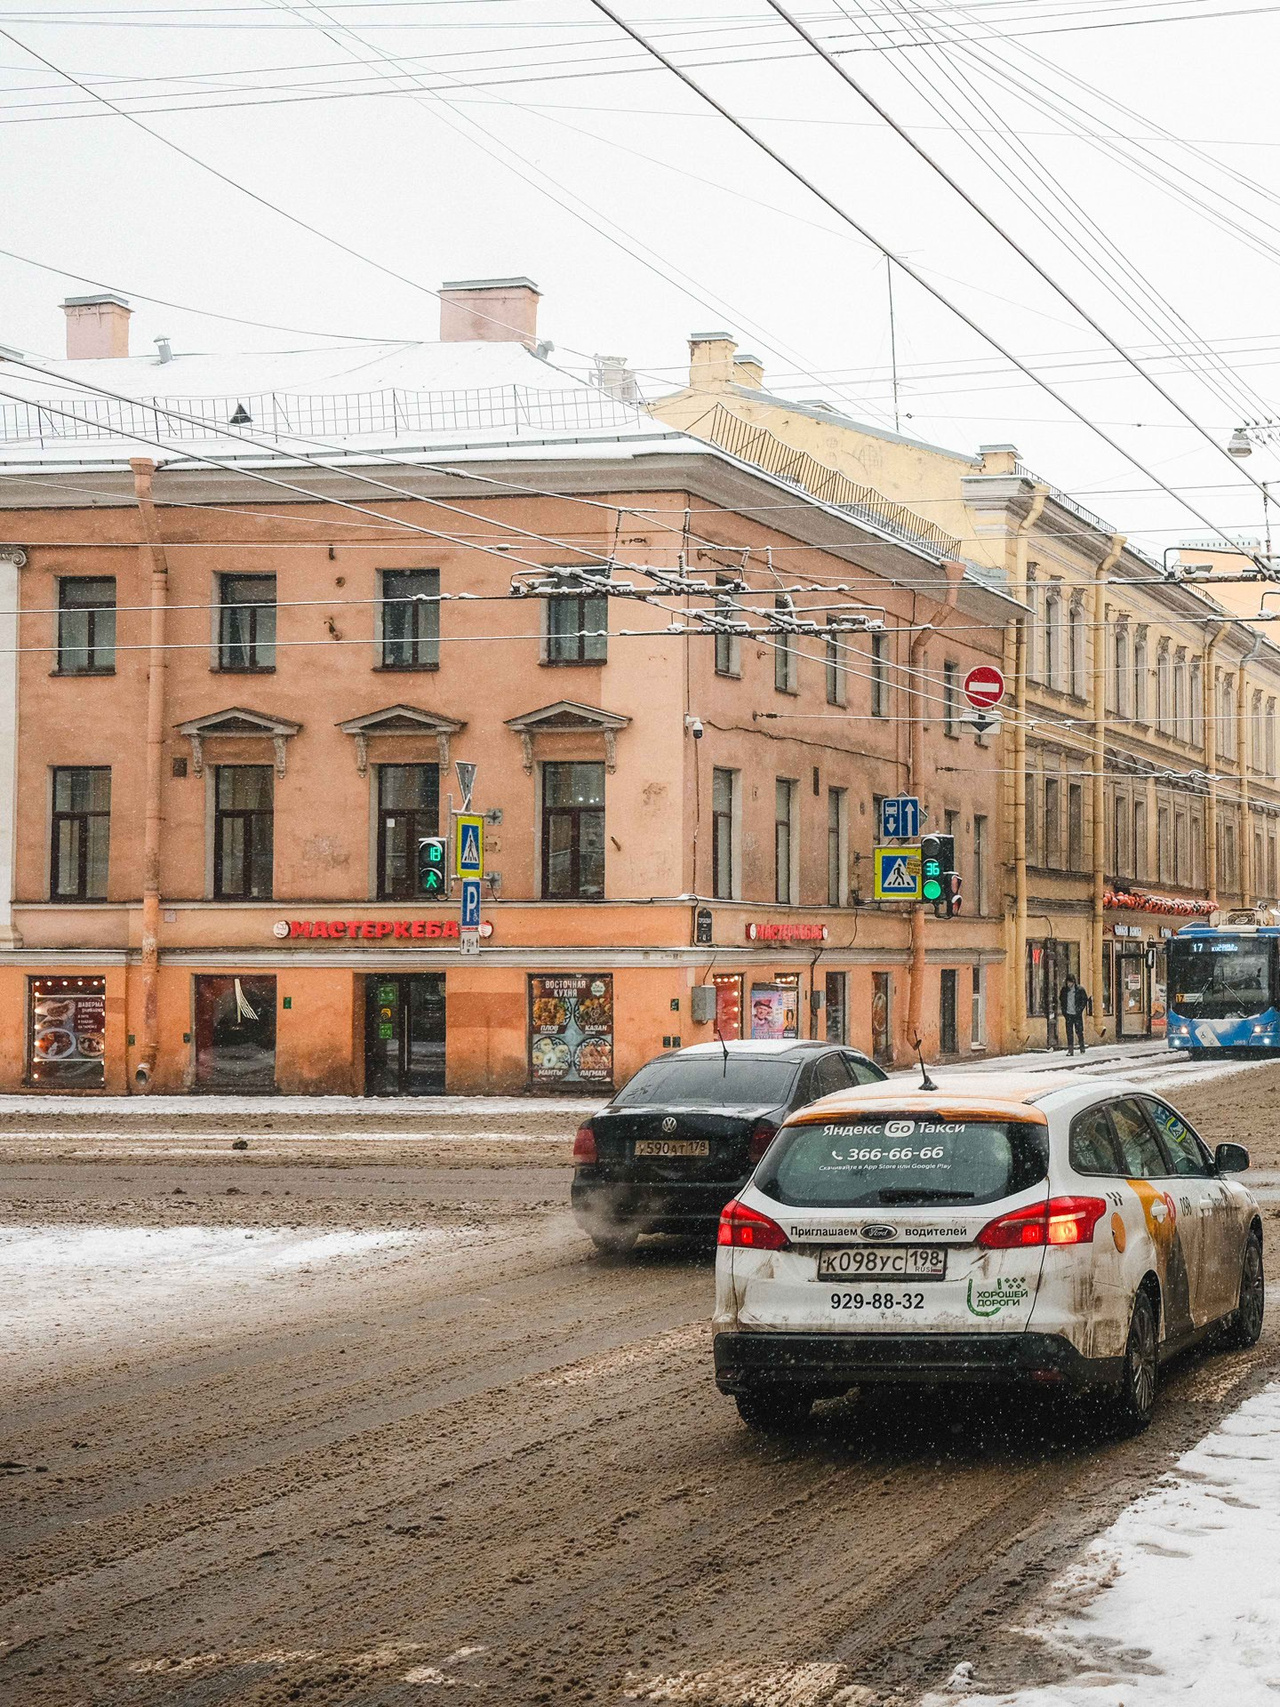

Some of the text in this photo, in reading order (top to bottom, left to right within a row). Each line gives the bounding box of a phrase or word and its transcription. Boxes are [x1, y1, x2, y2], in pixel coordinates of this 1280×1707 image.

[429, 846, 441, 862] 18
[925, 862, 940, 876] 36
[466, 886, 478, 922] P
[290, 920, 460, 938] МАСТЕРКЕБА
[1193, 943, 1203, 952] 17
[545, 980, 586, 989] ВОСТОЧНАЯ
[553, 989, 578, 997] КУХНЯ
[1177, 994, 1185, 1002] 17
[823, 1121, 966, 1136] Яндекс Go Такси
[847, 1146, 944, 1161] 366-66-66
[790, 1226, 858, 1238] Приглашаем
[868, 1227, 889, 1237] Ford
[905, 1226, 967, 1237] водителей
[826, 1250, 940, 1272] К098УС 198
[977, 1288, 1029, 1299] ХОРОШЕЙ
[831, 1293, 925, 1310] 929-88-32
[977, 1299, 1020, 1308] ДОРОГИ
